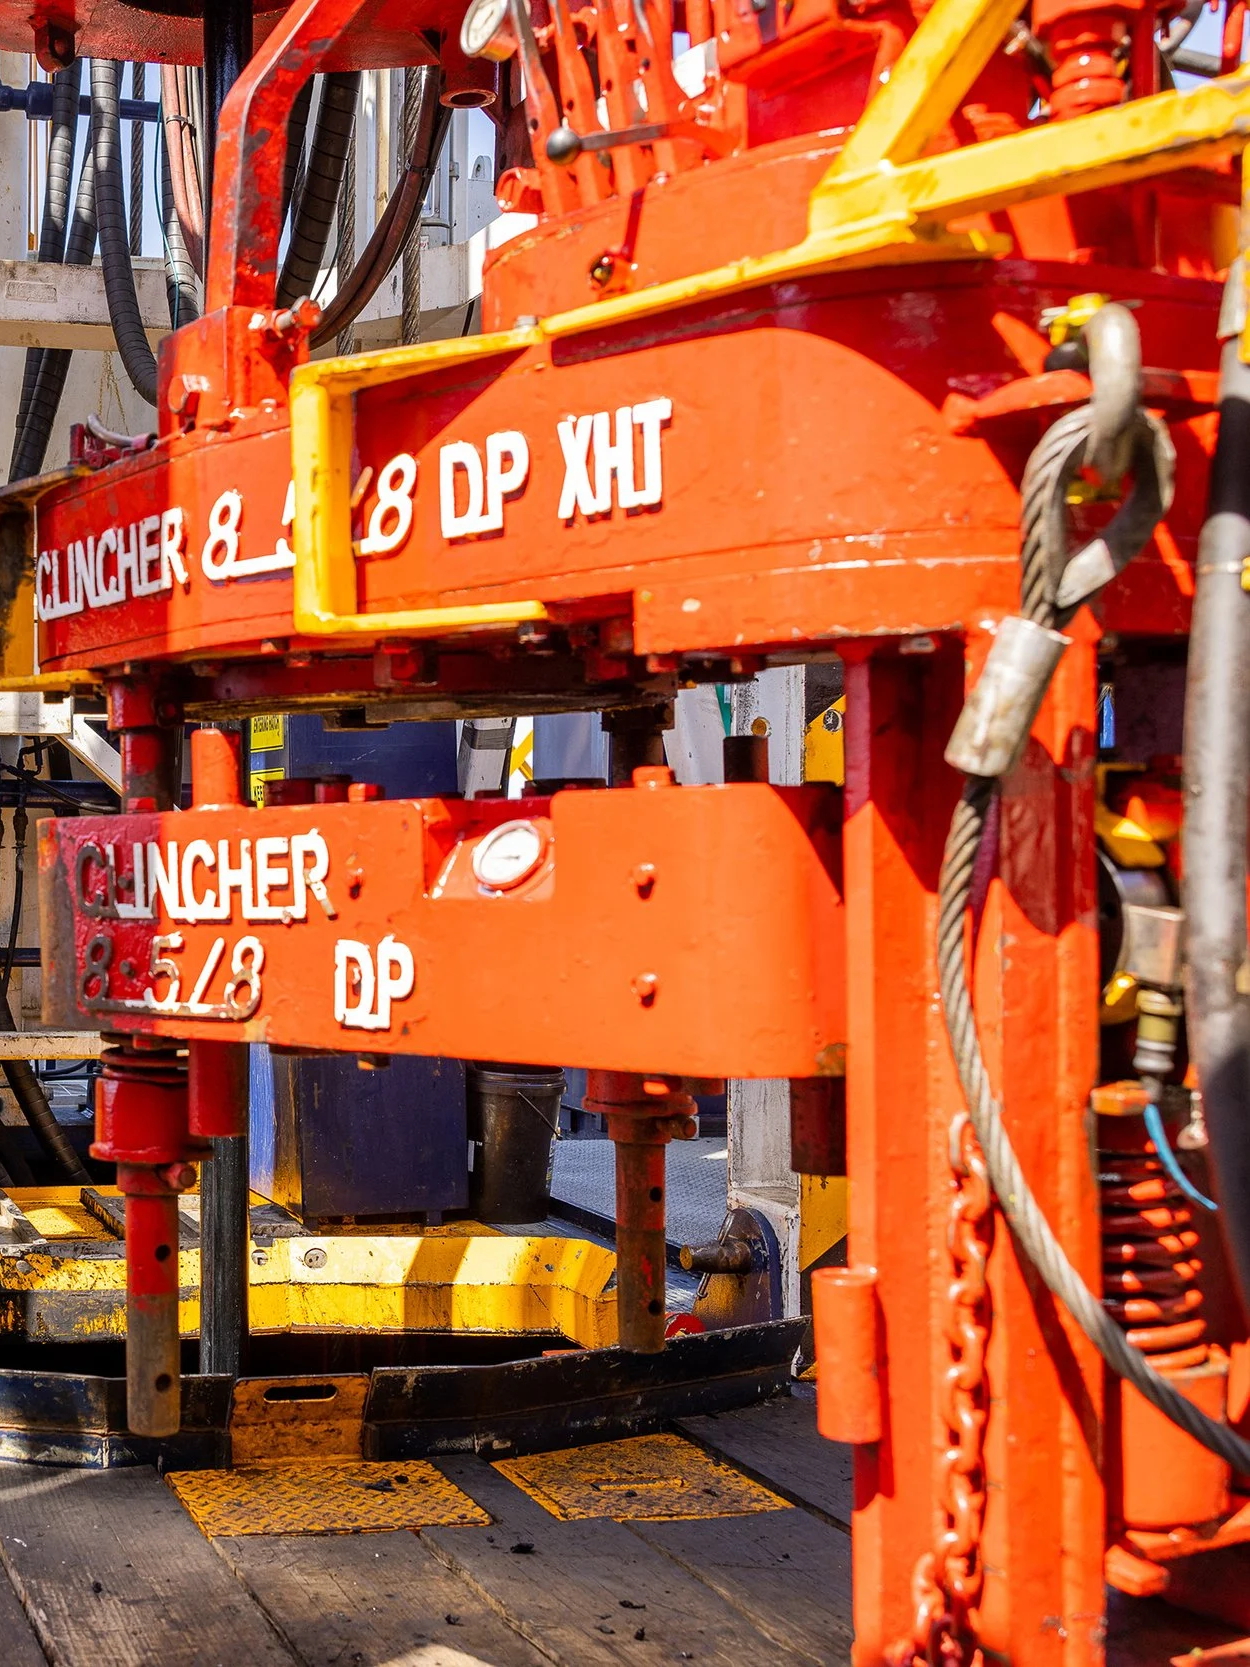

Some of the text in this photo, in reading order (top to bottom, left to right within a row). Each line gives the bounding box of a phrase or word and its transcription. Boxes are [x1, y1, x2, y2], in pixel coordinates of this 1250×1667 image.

[36, 506, 189, 622] CLINCHER
[440, 430, 529, 540] DP
[556, 396, 673, 520] XHT
[75, 828, 338, 924] CLINCHER
[334, 933, 415, 1029] DP
